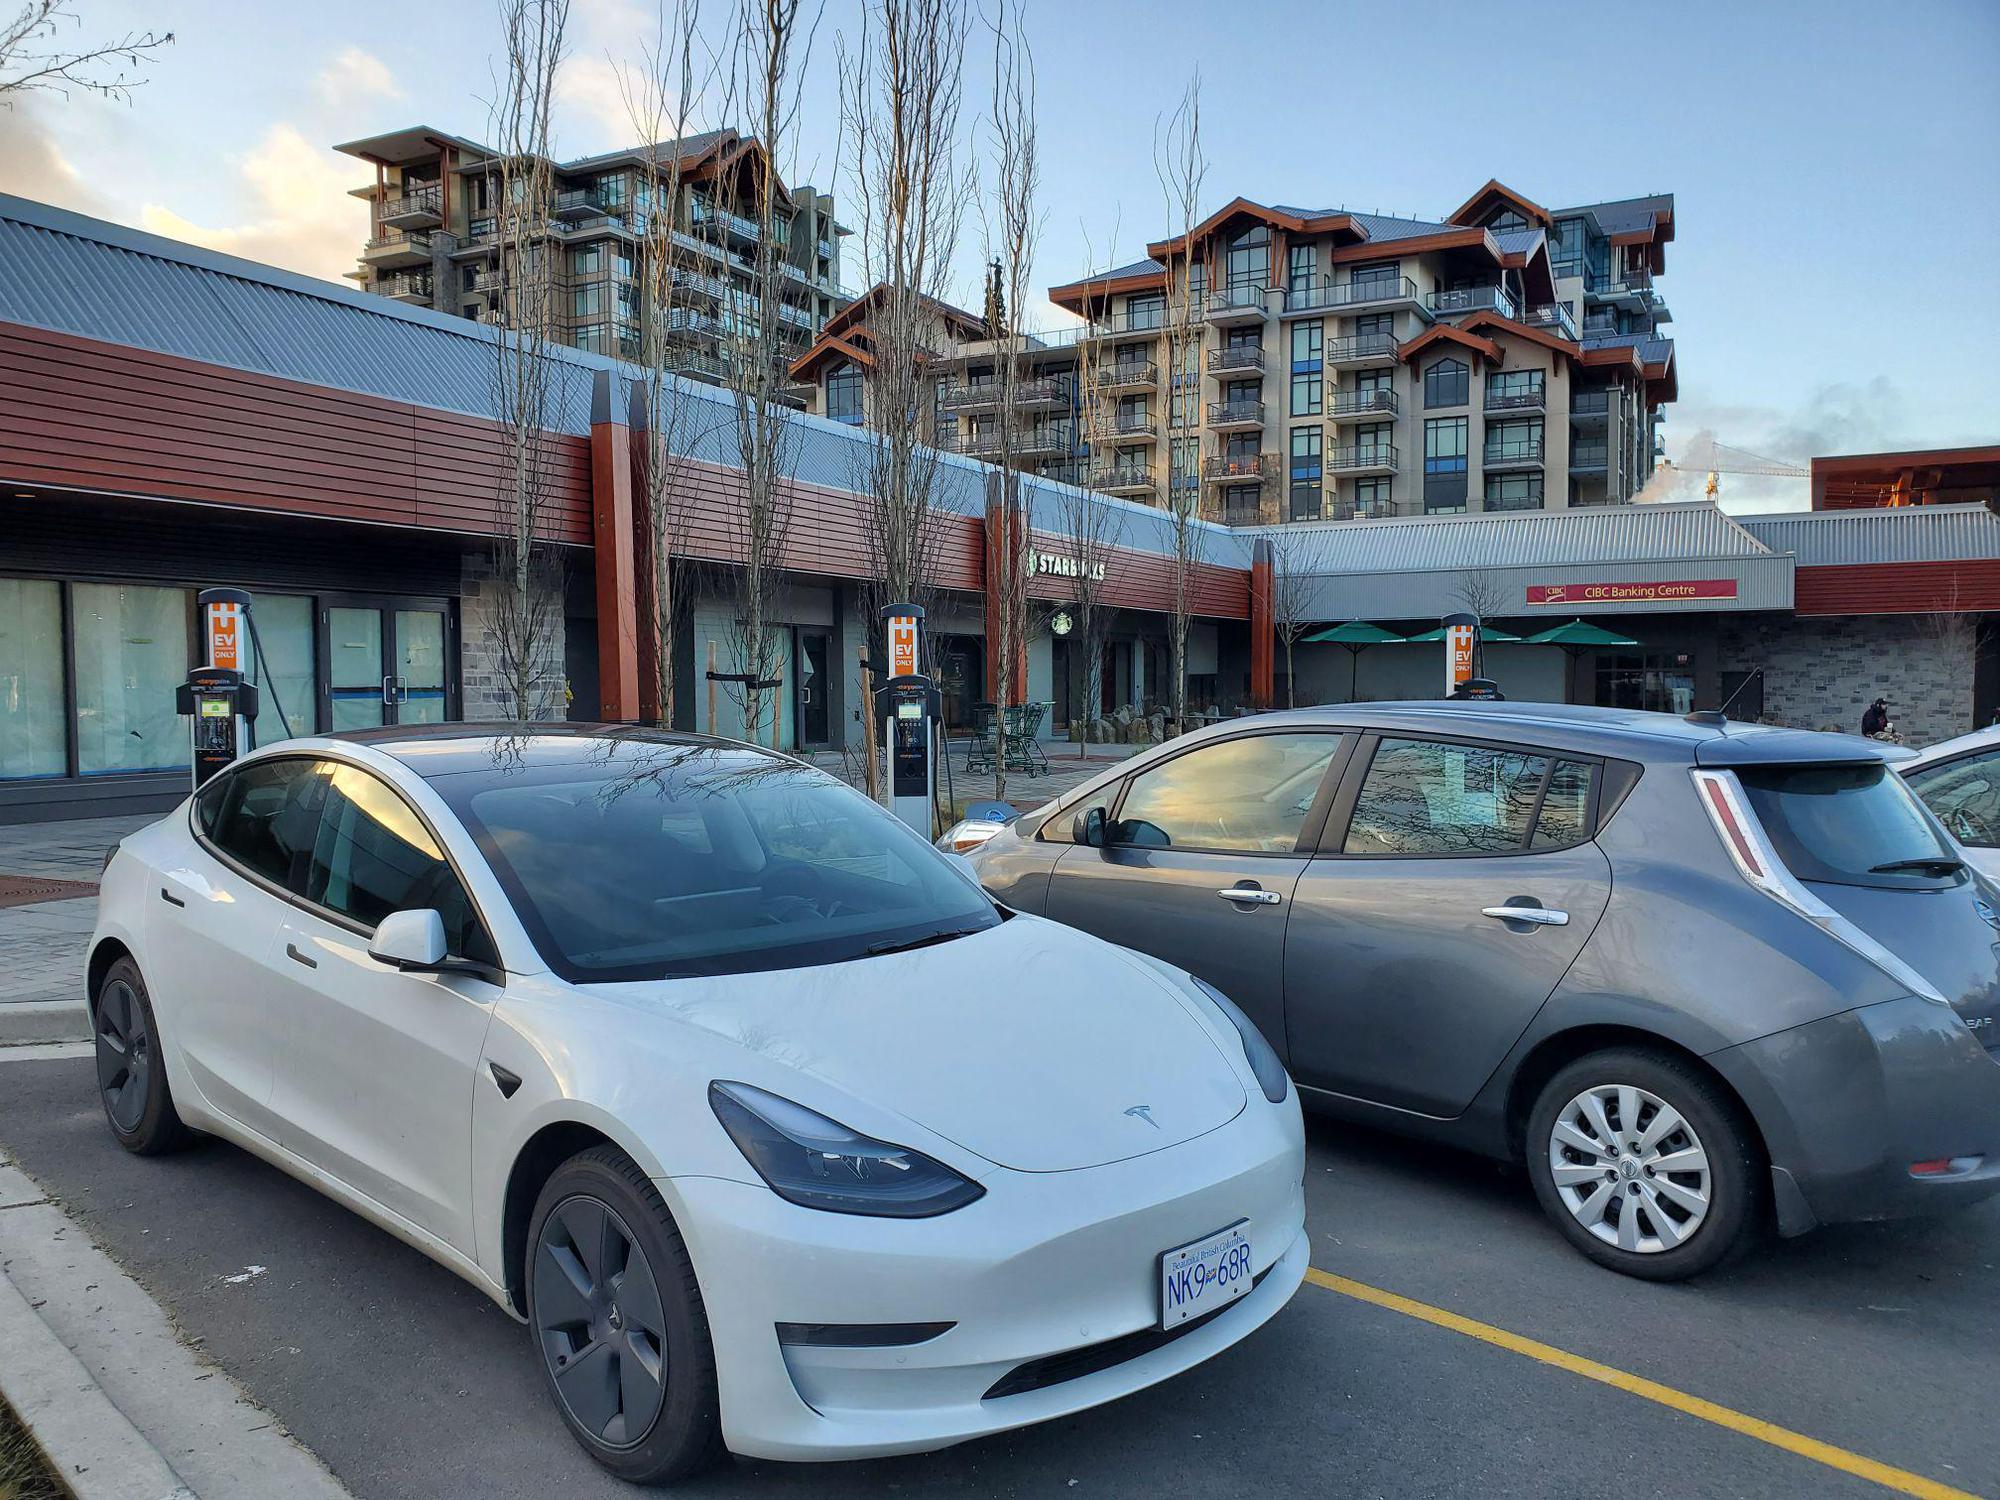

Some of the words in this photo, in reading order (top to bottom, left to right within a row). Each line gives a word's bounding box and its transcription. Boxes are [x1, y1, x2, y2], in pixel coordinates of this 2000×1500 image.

[1040, 554, 1105, 580] STARBUKS
[1547, 587, 1564, 595] CIBC
[1585, 587, 1609, 598] CIBC
[1612, 585, 1655, 598] Banking
[1658, 584, 1696, 596] Centre
[215, 633, 235, 646] EV
[896, 644, 912, 655] EV
[1456, 651, 1470, 661] EV
[1966, 1017, 1992, 1029] EAF
